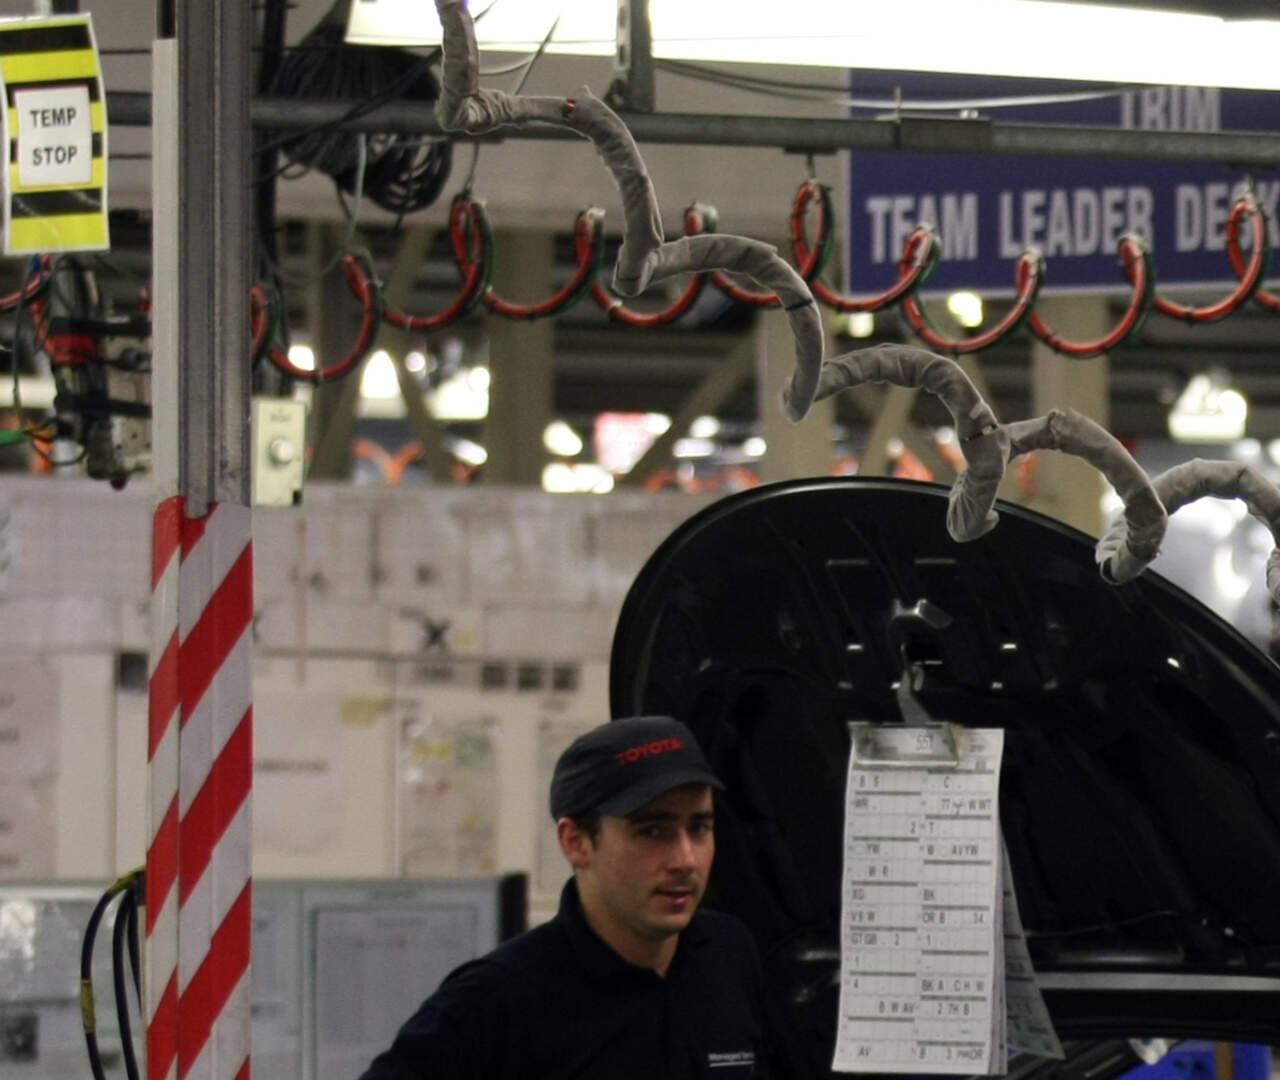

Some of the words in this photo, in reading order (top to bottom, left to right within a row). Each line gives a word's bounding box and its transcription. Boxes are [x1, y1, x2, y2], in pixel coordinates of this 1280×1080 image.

[30, 107, 77, 127] TEMP
[33, 145, 78, 166] STOP
[867, 194, 979, 263] TEAM
[999, 186, 1155, 260] LEADER
[616, 736, 685, 766] TOYOTA
